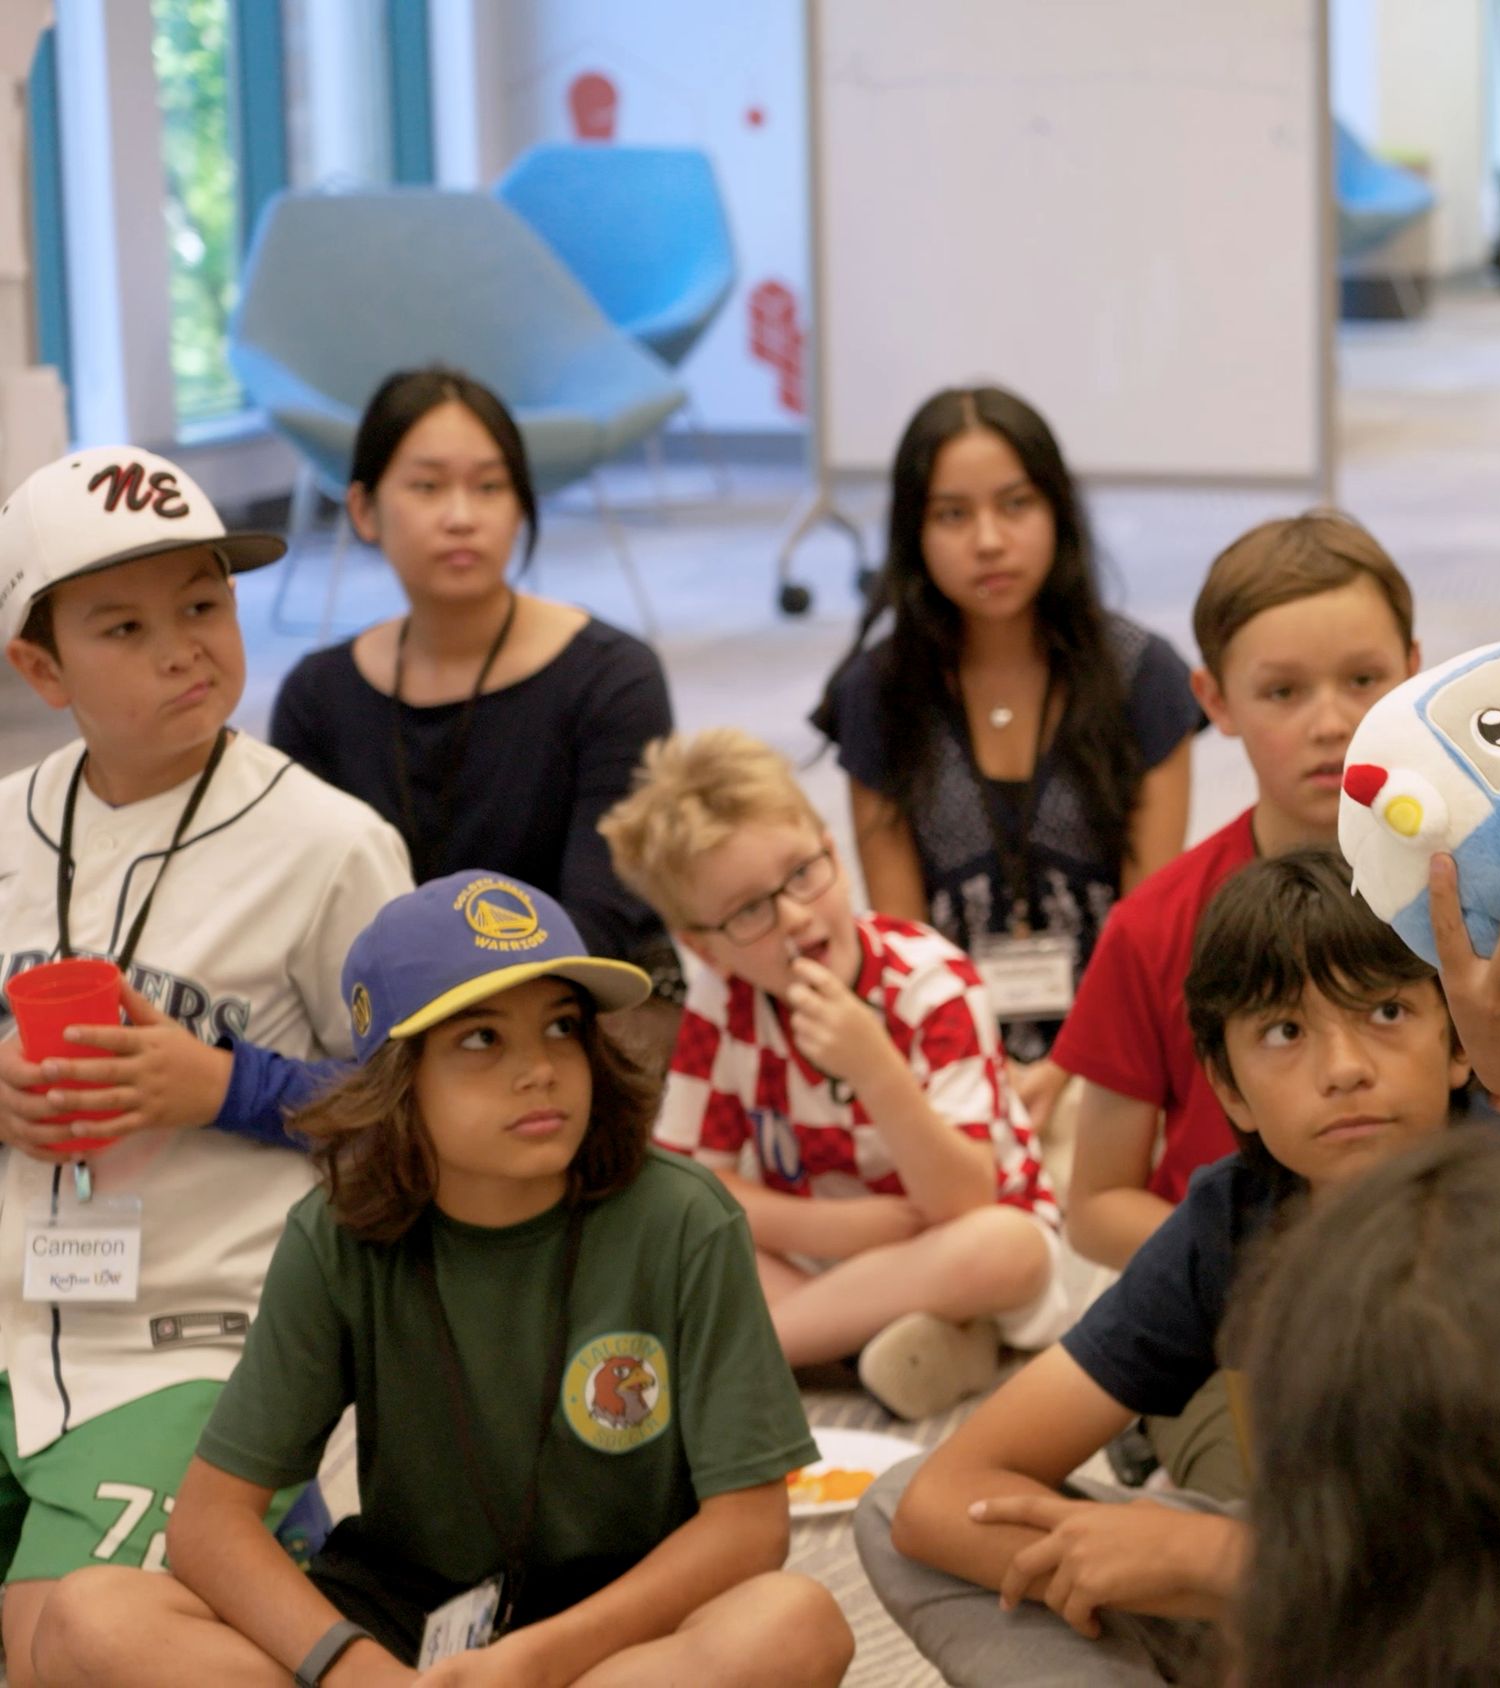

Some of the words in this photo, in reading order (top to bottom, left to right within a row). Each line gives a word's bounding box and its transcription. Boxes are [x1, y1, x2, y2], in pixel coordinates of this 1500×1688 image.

[87, 461, 190, 520] NE
[474, 928, 548, 952] WARRIORS
[32, 1235, 125, 1257] Cameron
